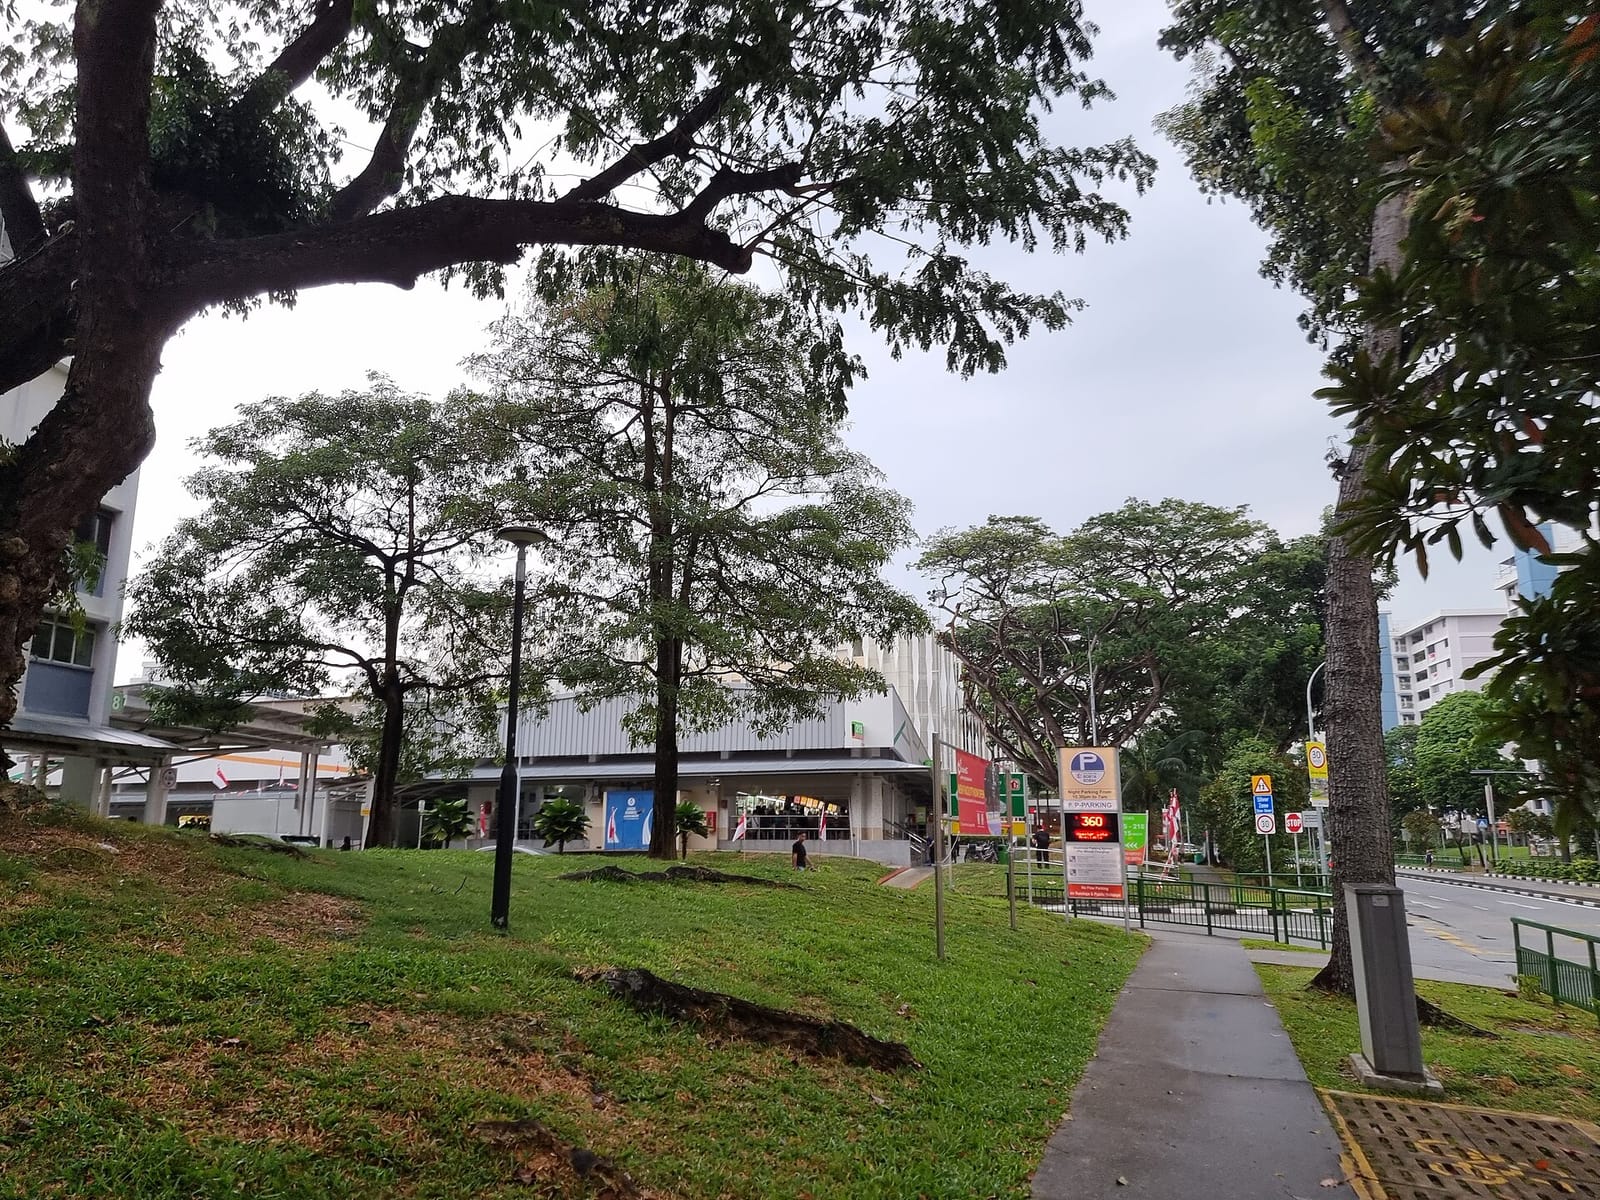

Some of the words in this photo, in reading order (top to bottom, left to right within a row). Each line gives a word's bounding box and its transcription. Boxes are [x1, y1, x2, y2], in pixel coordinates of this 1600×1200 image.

[1312, 750, 1321, 759] 30
[1079, 753, 1098, 770] P
[1080, 816, 1103, 827] 360
[1287, 819, 1301, 827] STOP
